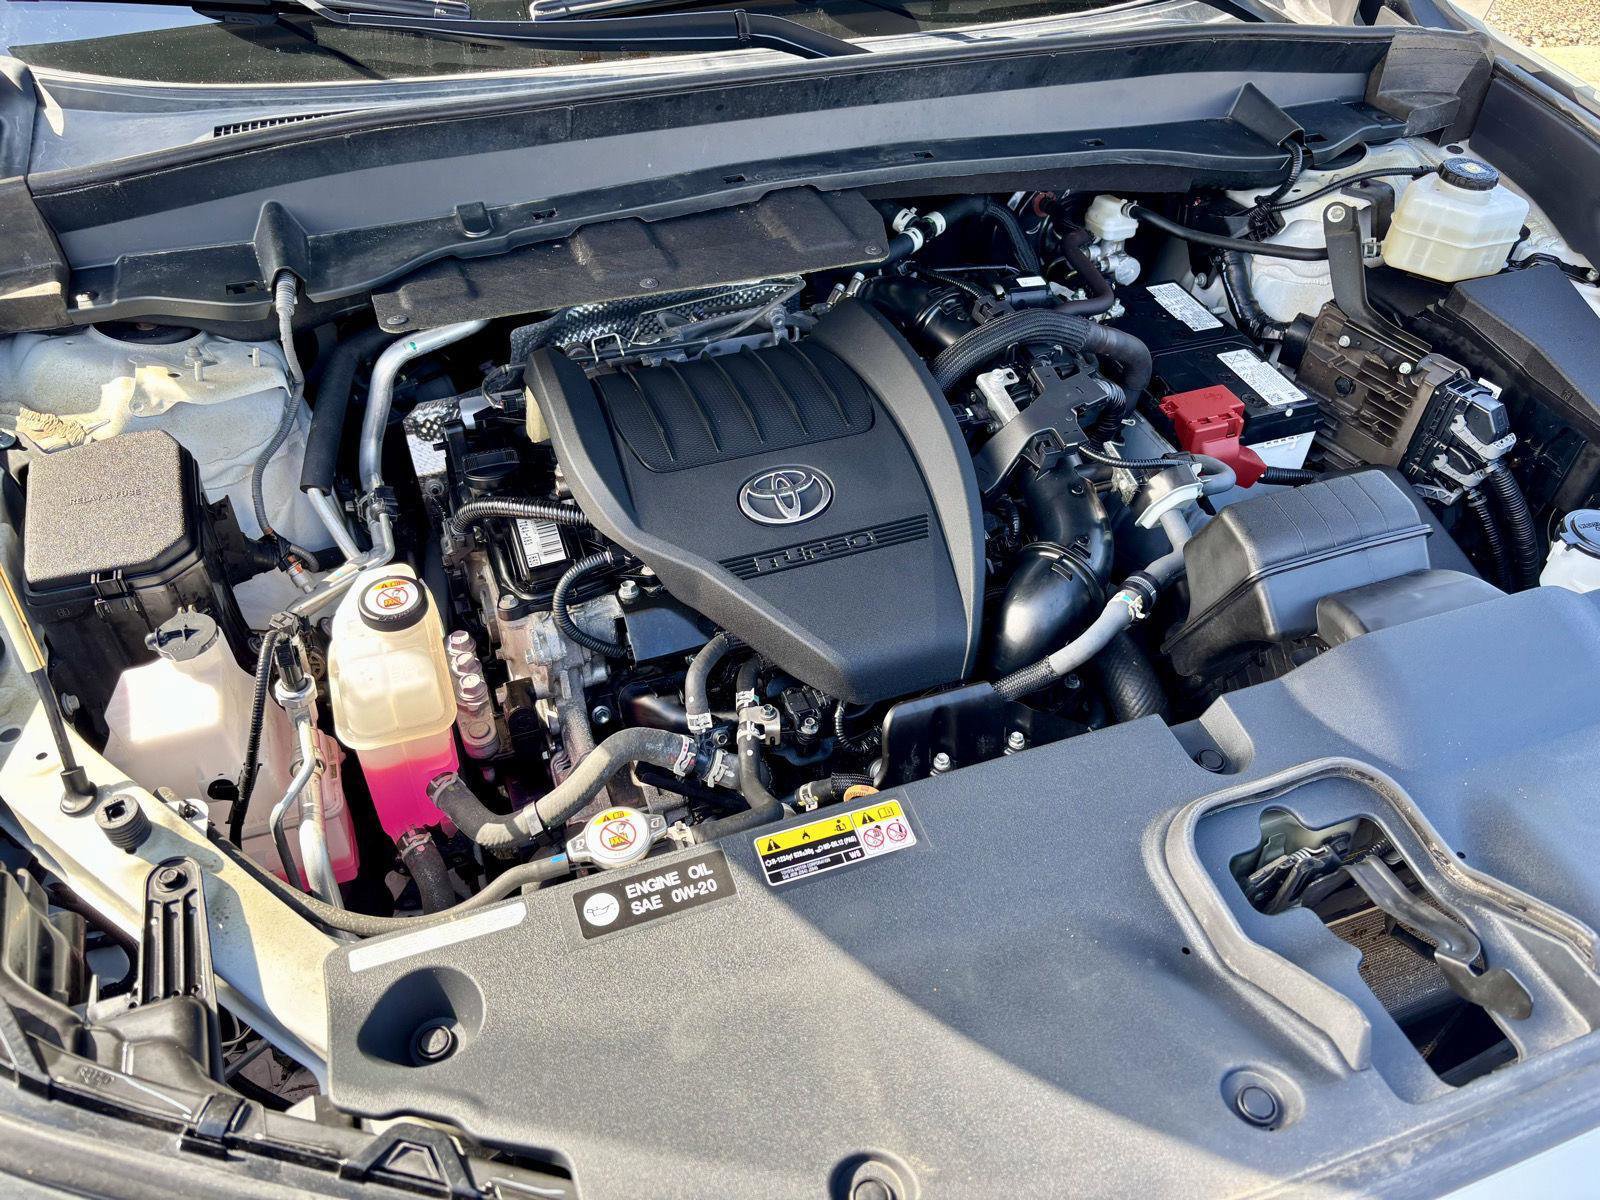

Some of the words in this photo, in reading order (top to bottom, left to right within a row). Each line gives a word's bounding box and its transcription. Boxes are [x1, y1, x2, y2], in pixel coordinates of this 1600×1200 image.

[753, 531, 880, 573] TURBO
[625, 870, 681, 899] ENGINE
[687, 862, 714, 879] OIL
[630, 894, 664, 916] SAE
[671, 878, 718, 903] 0W-20
